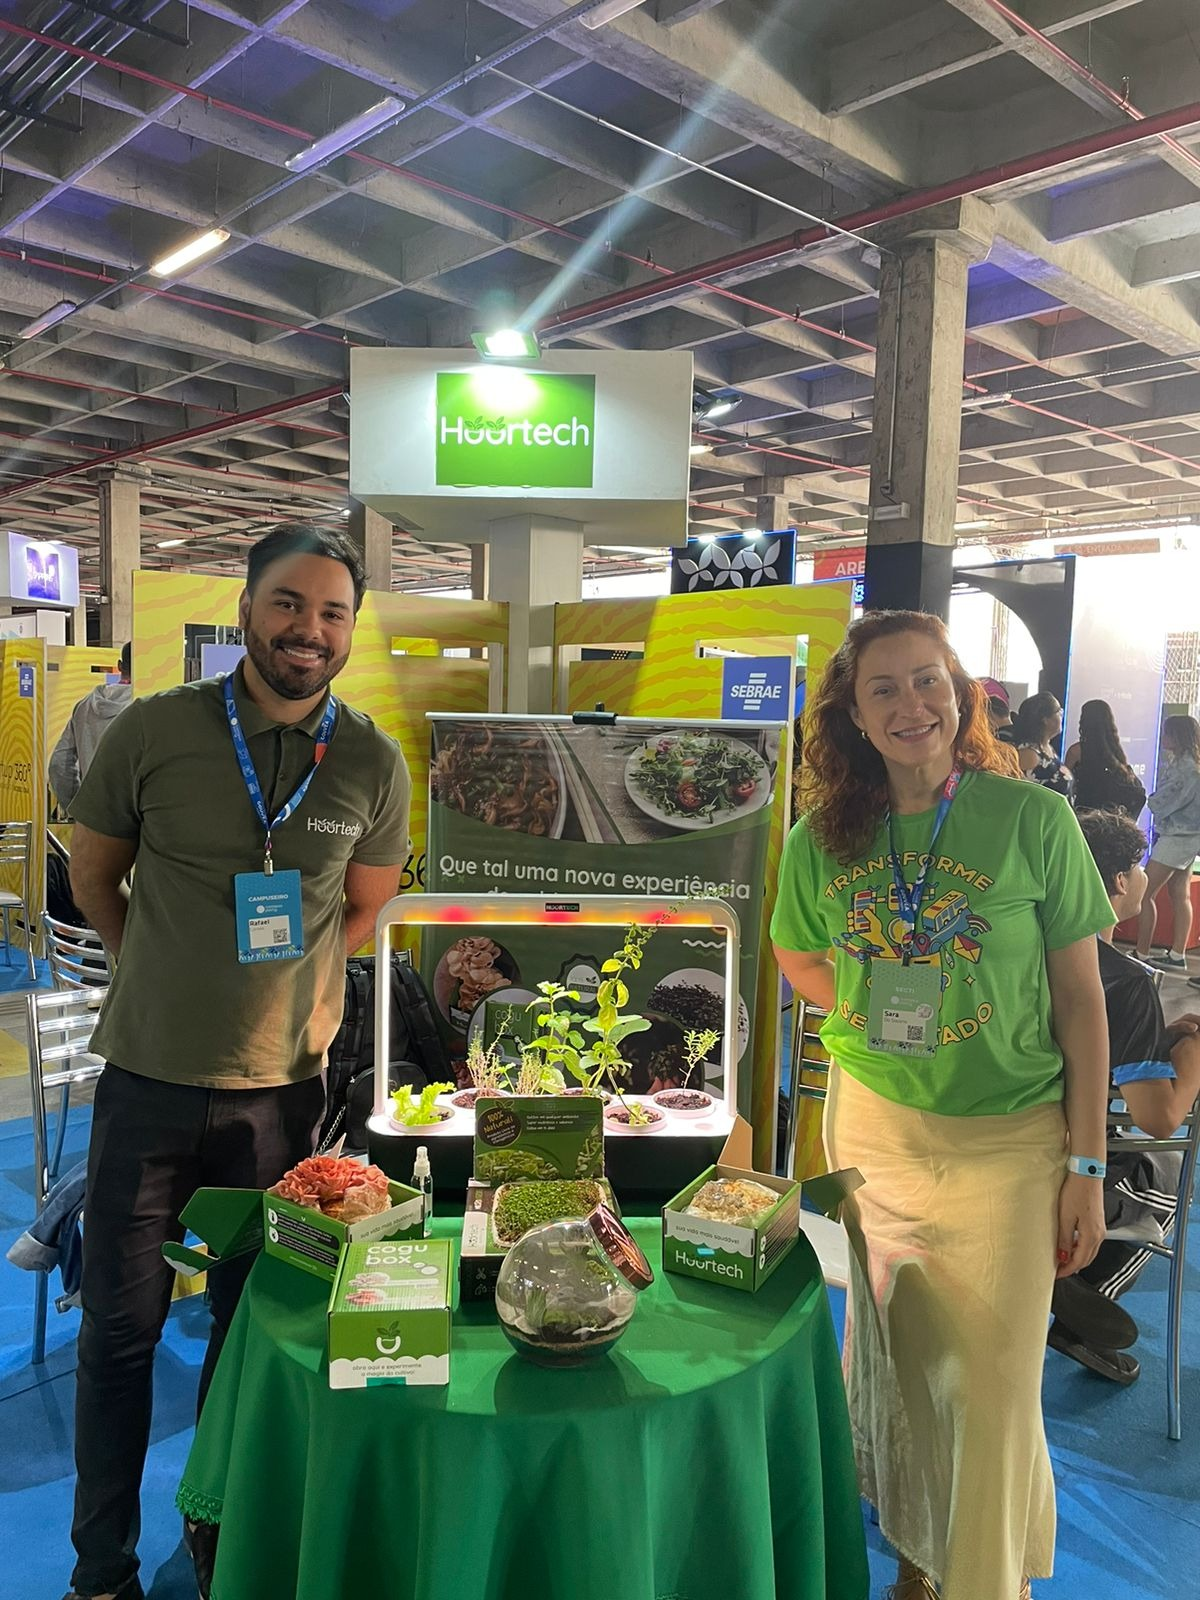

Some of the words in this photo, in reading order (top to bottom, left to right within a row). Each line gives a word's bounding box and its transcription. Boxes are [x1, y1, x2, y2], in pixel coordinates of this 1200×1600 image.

[731, 685, 782, 698] SEBRAE
[440, 855, 477, 877] Que
[483, 860, 508, 877] tal
[515, 865, 558, 882] uma
[565, 869, 615, 887] nova
[622, 873, 750, 899] experiência
[824, 852, 995, 900] TRANSFORME
[248, 894, 289, 902] CAMPUSEIRO
[884, 1010, 899, 1018] Sara
[367, 1244, 428, 1255] cogu
[366, 1255, 412, 1265] box
